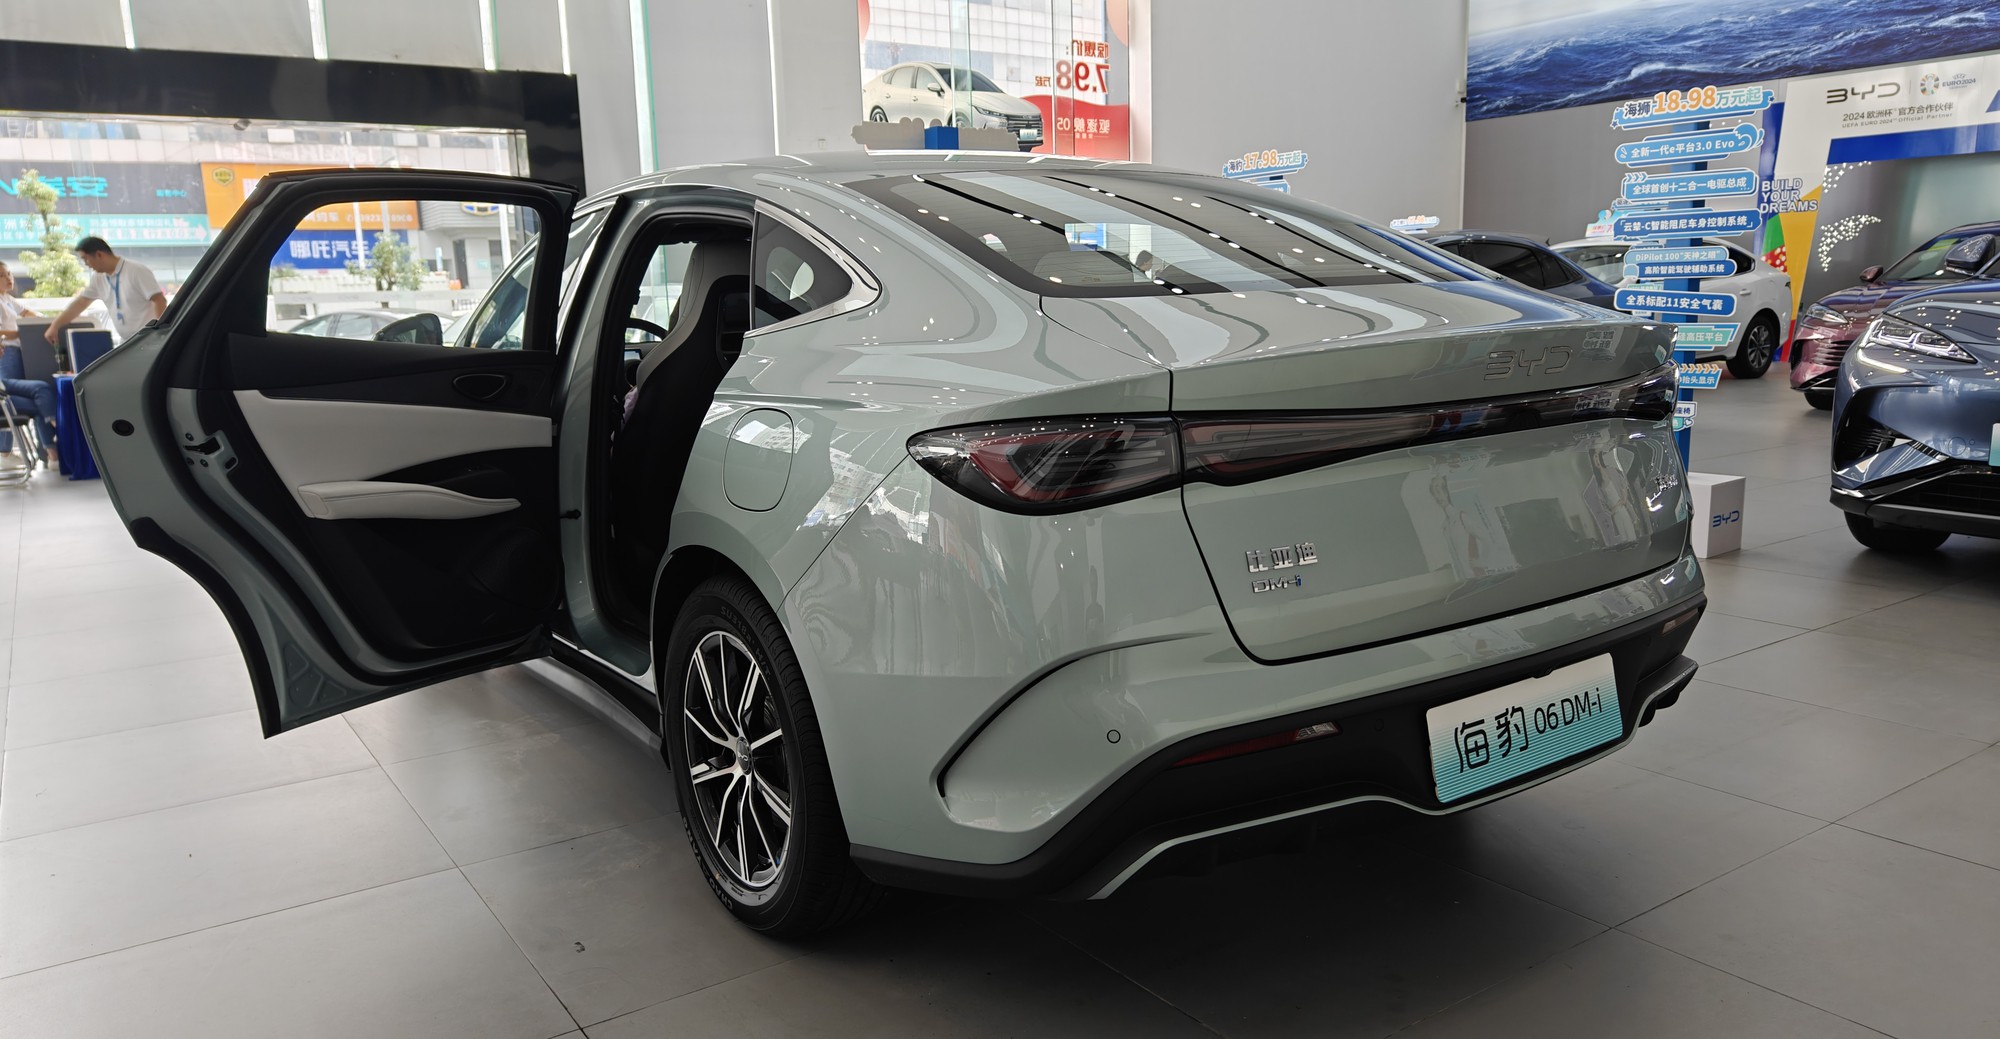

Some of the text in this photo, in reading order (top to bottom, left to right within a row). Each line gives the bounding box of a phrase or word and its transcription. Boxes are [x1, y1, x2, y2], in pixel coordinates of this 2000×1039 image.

[1826, 82, 1901, 104] BYD
[1842, 112, 1865, 122] 2024
[1898, 103, 1954, 115] 官方合作伙伴
[1631, 139, 1735, 158] 全新一代e平台3.0 Evo
[1632, 176, 1748, 195] 全球首创十二合一电驱总成
[1761, 178, 1803, 191] BUILD
[1762, 190, 1801, 203] YOUR
[1760, 200, 1818, 214] DREAMS
[1635, 252, 1663, 261] DiPilot
[1644, 263, 1725, 274] 高阶智能驾驶辅助系统
[1626, 294, 1724, 311] 全系标配11安全气囊
[1484, 346, 1573, 381] BYD
[1712, 510, 1740, 528] BYD
[1245, 542, 1318, 573] 比亚迪
[1252, 575, 1302, 593] DM-i
